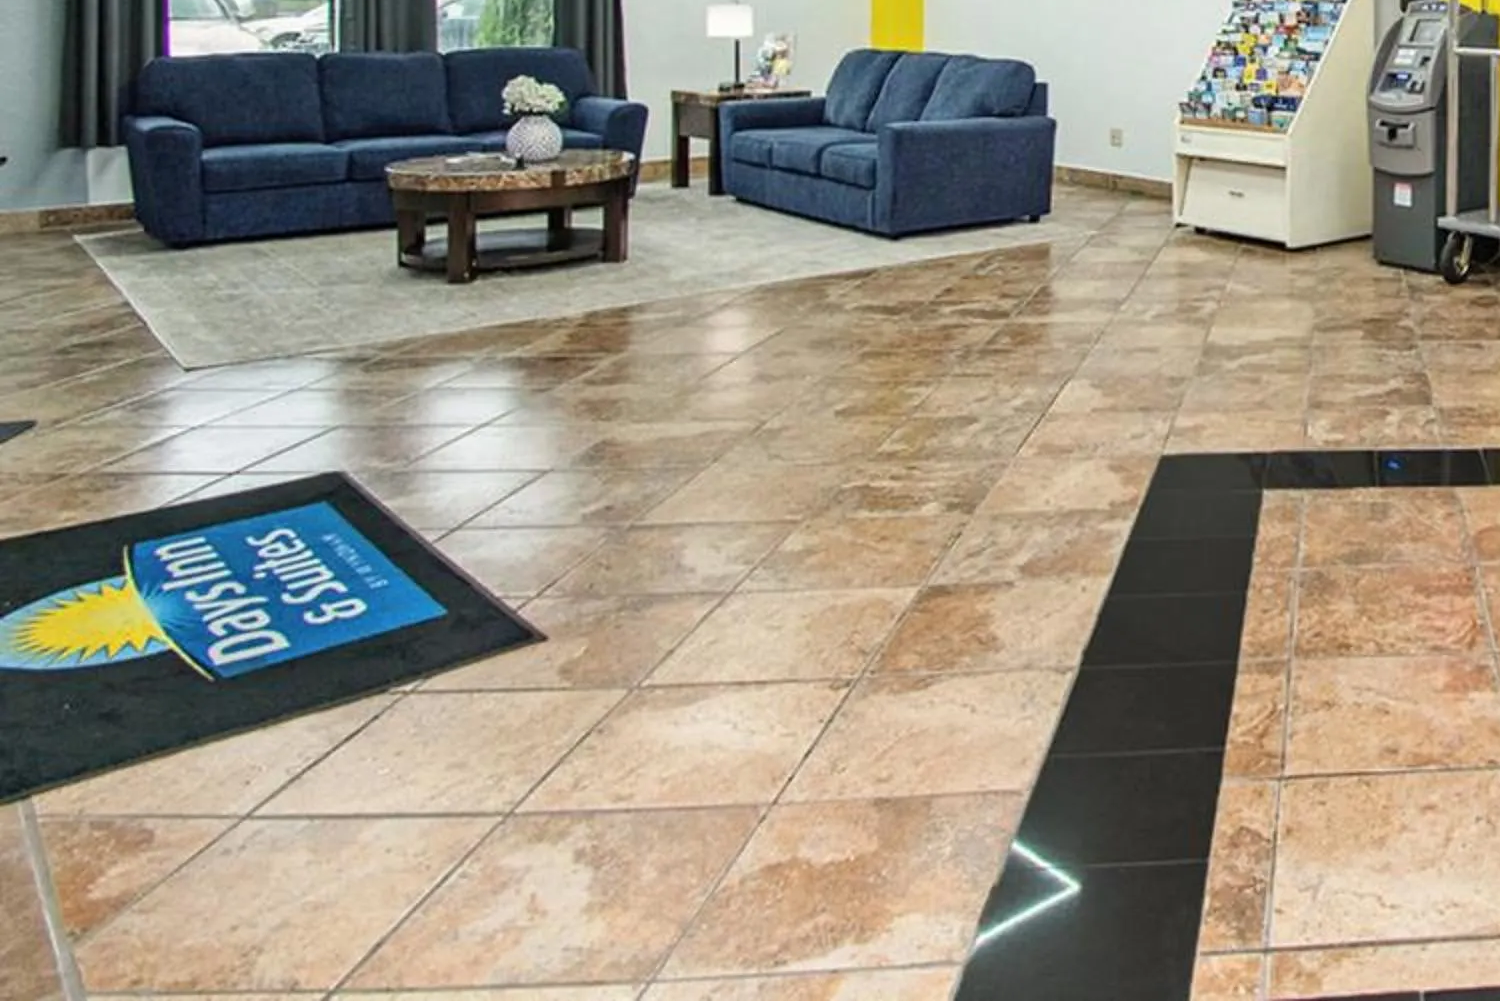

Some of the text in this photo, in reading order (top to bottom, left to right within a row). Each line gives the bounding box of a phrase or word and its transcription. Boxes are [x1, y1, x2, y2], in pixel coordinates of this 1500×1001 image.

[154, 536, 291, 667] Days Inn
[245, 527, 368, 626] & Suites
